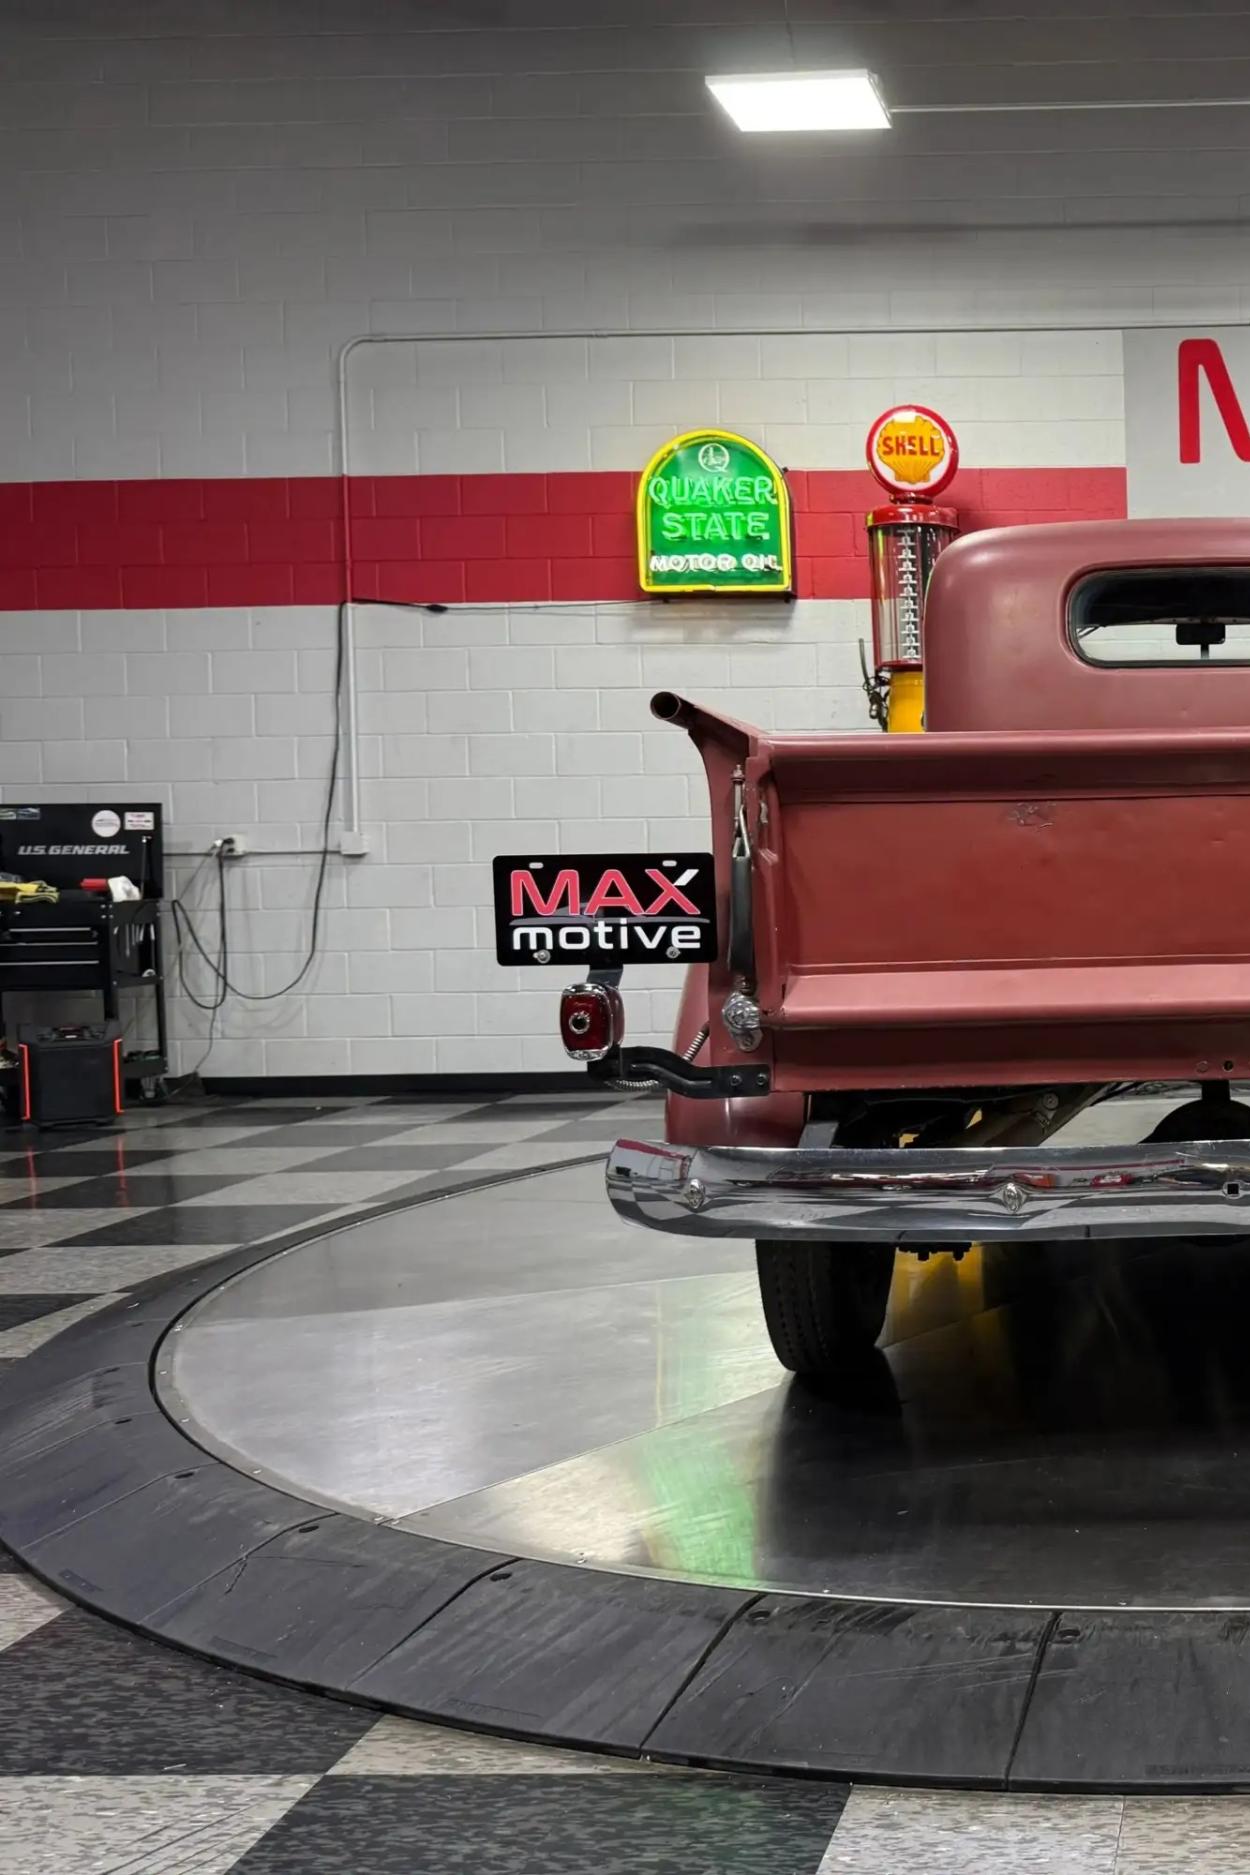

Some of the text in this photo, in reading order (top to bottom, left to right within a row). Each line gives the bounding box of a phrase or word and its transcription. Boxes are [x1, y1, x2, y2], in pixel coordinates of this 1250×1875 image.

[882, 435, 940, 456] SHELL
[648, 475, 778, 509] QUAKER
[662, 511, 770, 541] STATE
[650, 553, 783, 573] MOTOR OIL
[48, 845, 130, 855] GENERAL
[510, 868, 701, 916] MAX
[512, 917, 701, 950] motive
